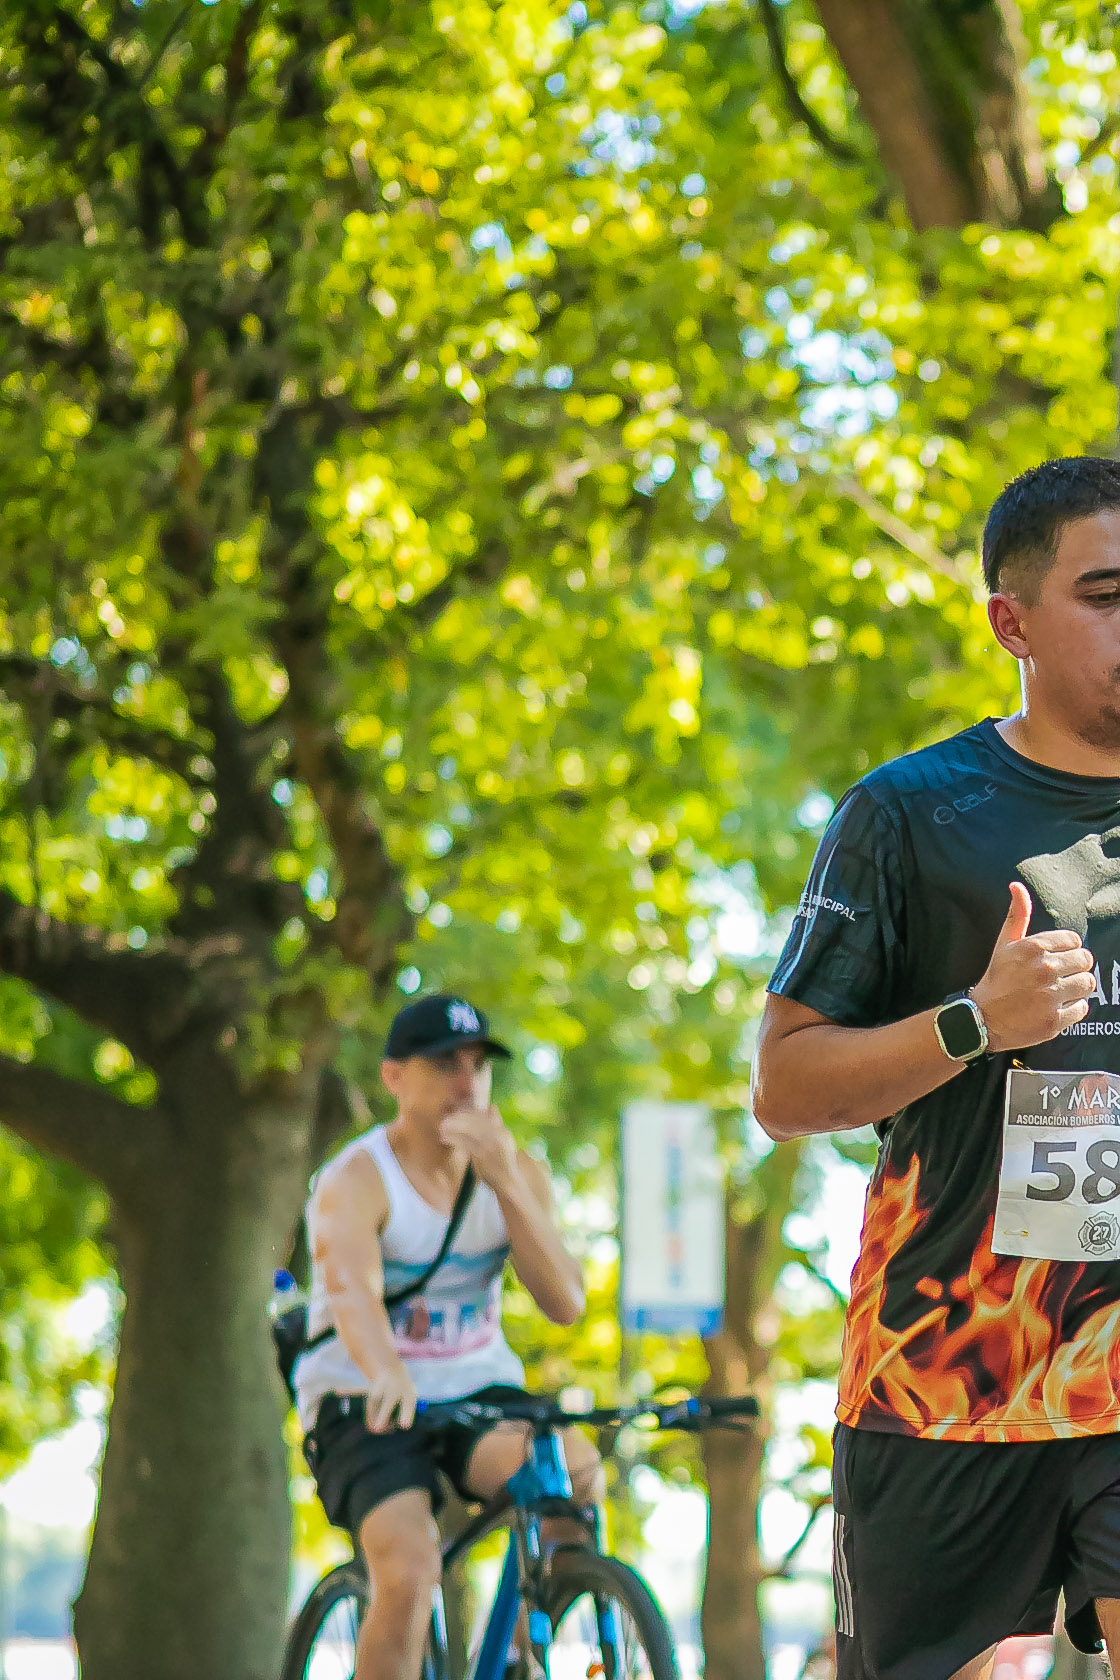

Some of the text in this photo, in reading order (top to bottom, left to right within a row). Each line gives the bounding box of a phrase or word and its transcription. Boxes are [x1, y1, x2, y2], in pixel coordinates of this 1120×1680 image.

[1060, 1021, 1120, 1036] OMBEROS
[1016, 1113, 1069, 1126] ASOCIACIÓN
[1070, 1113, 1116, 1126] BOMBEROS
